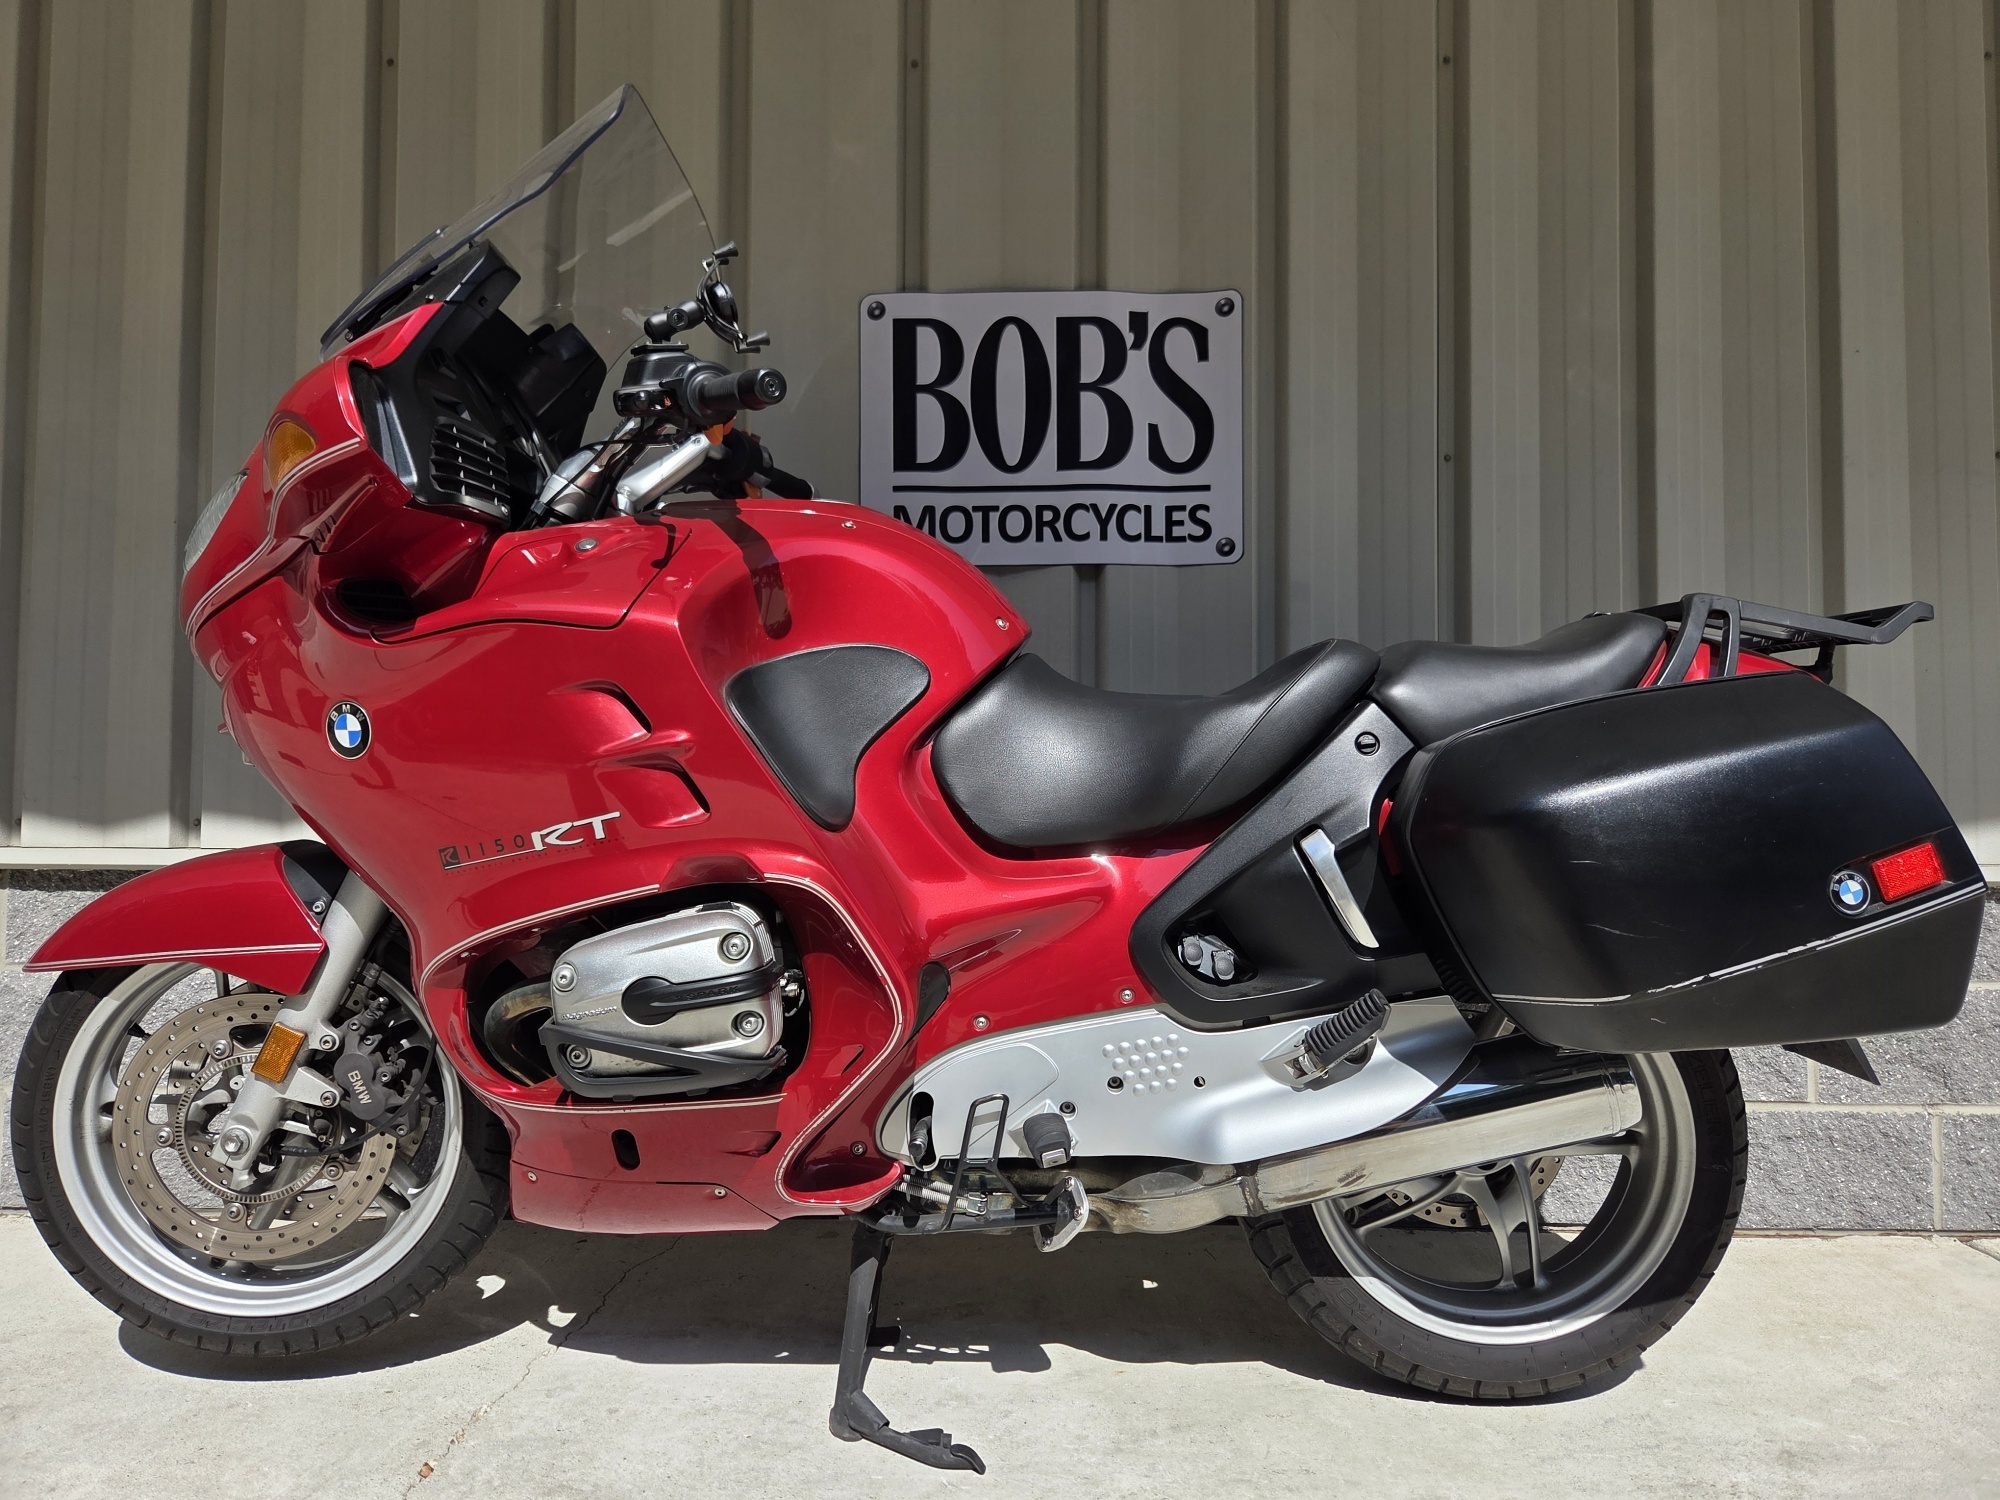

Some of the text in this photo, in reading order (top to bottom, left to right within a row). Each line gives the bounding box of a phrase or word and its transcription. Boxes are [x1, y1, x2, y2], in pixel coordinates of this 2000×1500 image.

[892, 311, 1215, 475] BOB'S
[892, 503, 1213, 544] MOTORCYCLES
[330, 704, 365, 722] BMW
[348, 1070, 373, 1105] BMW
